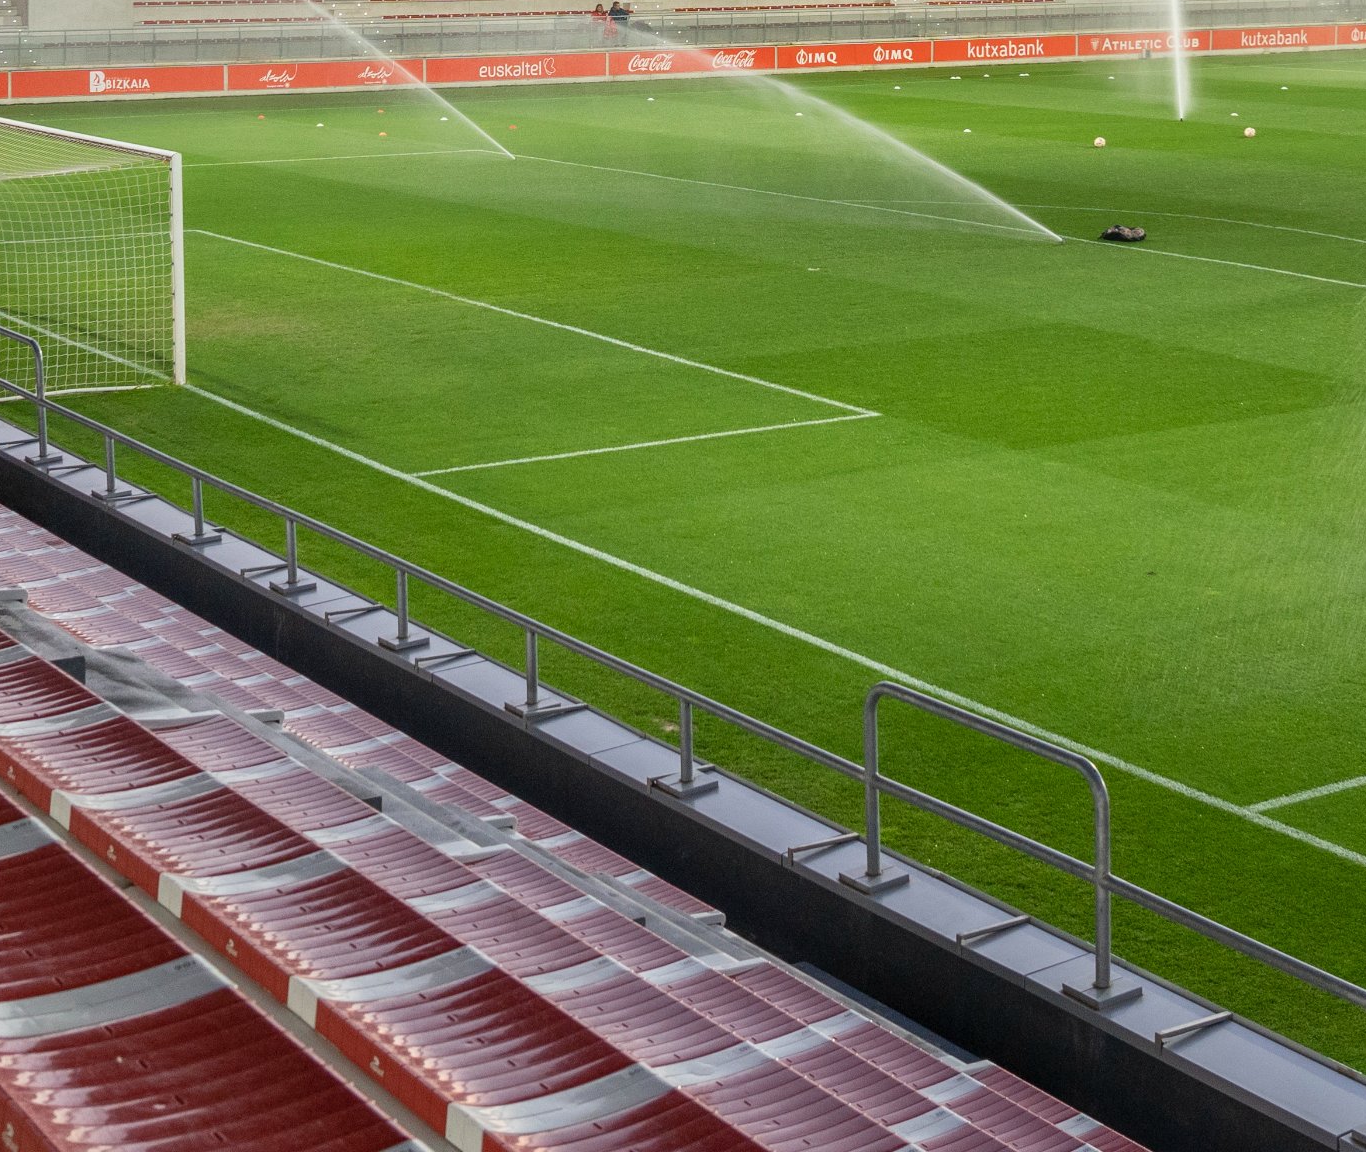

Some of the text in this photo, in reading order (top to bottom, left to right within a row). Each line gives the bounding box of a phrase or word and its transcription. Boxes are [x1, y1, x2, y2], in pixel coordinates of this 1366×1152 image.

[1240, 29, 1308, 47] kutxabank
[885, 48, 914, 61] IMQ
[967, 38, 1045, 58] kutxabank
[628, 53, 674, 72] Coca-Cola
[712, 49, 757, 69] Coca-Cola
[808, 51, 838, 64] IMQ
[479, 60, 542, 78] euskaltel
[106, 78, 151, 89] BIZKAIA
